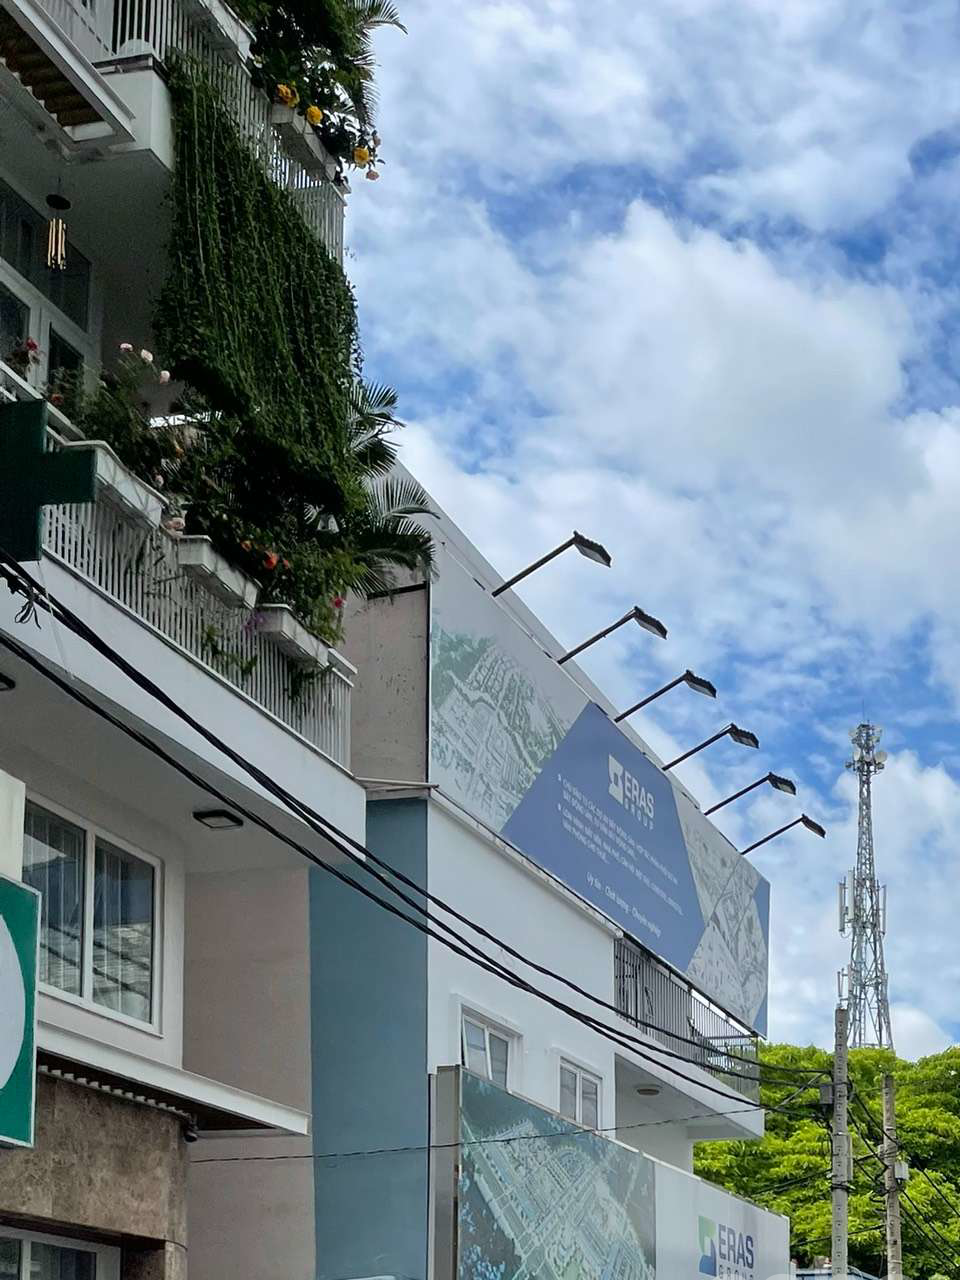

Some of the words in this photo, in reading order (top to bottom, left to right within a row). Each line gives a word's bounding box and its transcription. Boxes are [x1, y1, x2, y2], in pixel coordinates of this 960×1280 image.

[624, 769, 655, 819] ERAS
[624, 797, 655, 831] GROUP
[718, 1223, 754, 1270] ERAS
